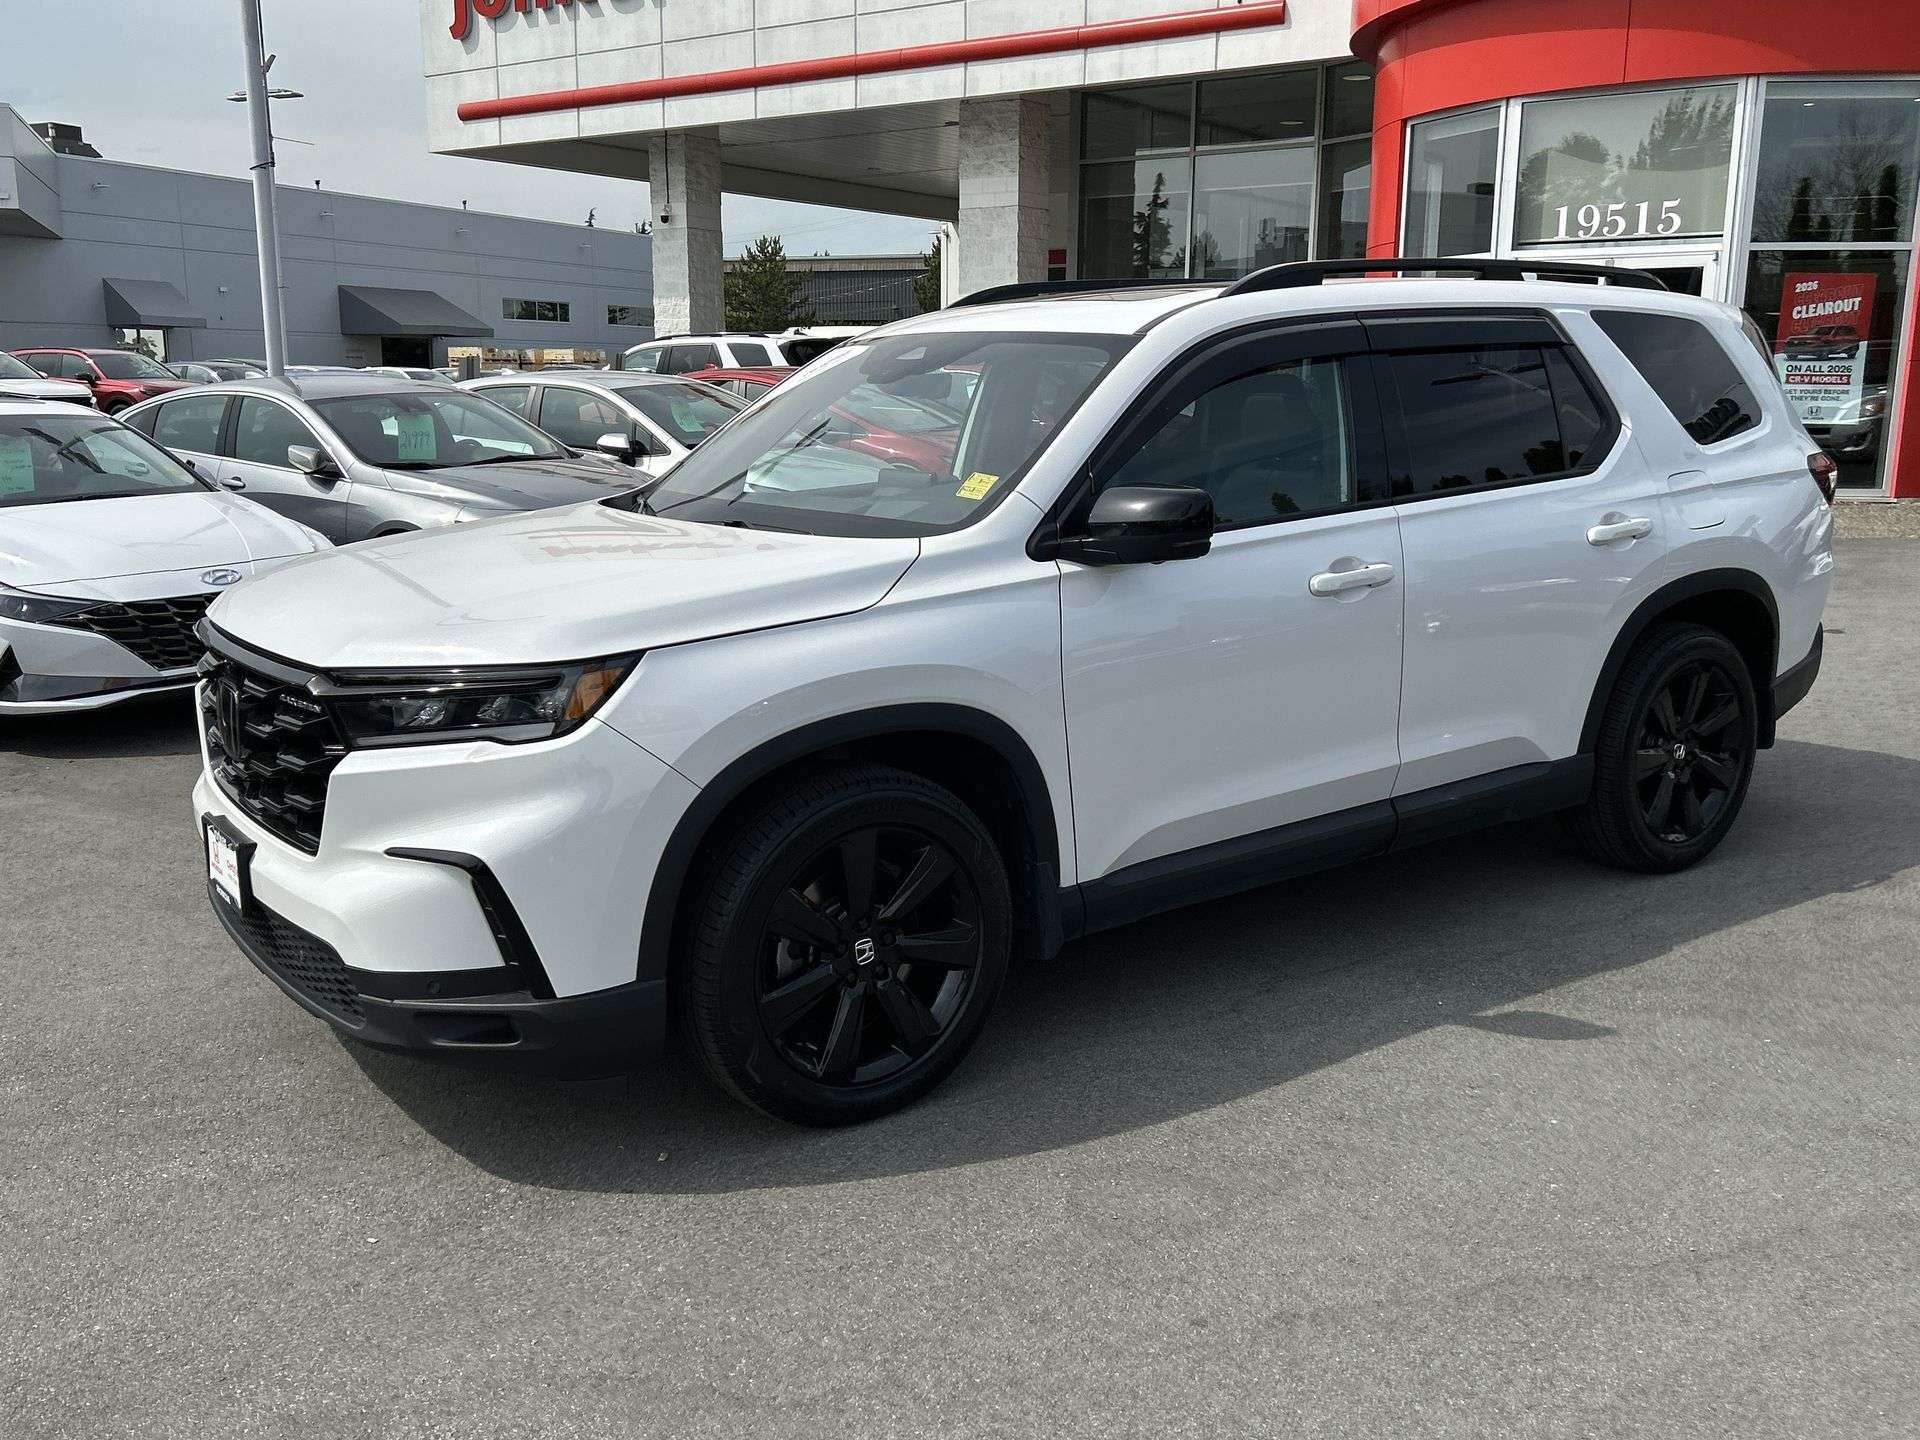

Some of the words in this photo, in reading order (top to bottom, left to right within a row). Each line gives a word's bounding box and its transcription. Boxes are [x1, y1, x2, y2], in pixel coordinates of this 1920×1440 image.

[1553, 198, 1682, 240] 19515
[1794, 281, 1819, 293] 2026
[1792, 297, 1862, 320] CLEAROUT
[1786, 364, 1802, 373] ON
[1804, 364, 1825, 373] ALL
[1827, 365, 1853, 373] 2026
[1788, 375, 1810, 383] CR-V
[1811, 375, 1848, 384] MODELS
